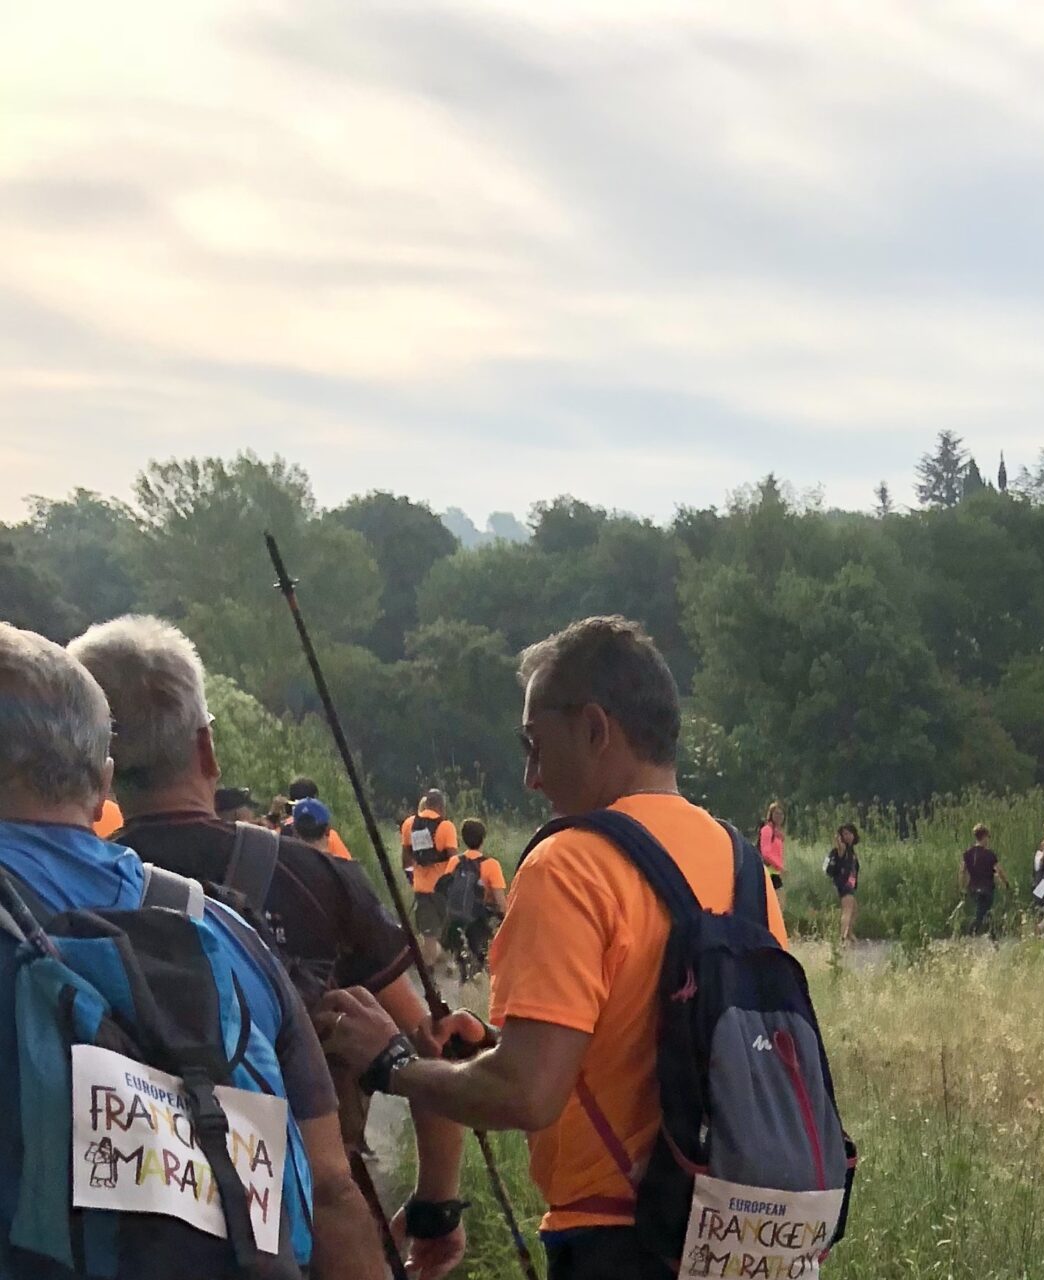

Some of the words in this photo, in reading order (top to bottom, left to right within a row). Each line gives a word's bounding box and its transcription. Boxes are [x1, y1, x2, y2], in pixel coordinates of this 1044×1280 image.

[124, 1072, 190, 1112] EUROPEA
[89, 1084, 273, 1178] FRANCINA
[728, 1197, 787, 1217] EUROPEAN
[698, 1207, 827, 1249] FRANCIGENA
